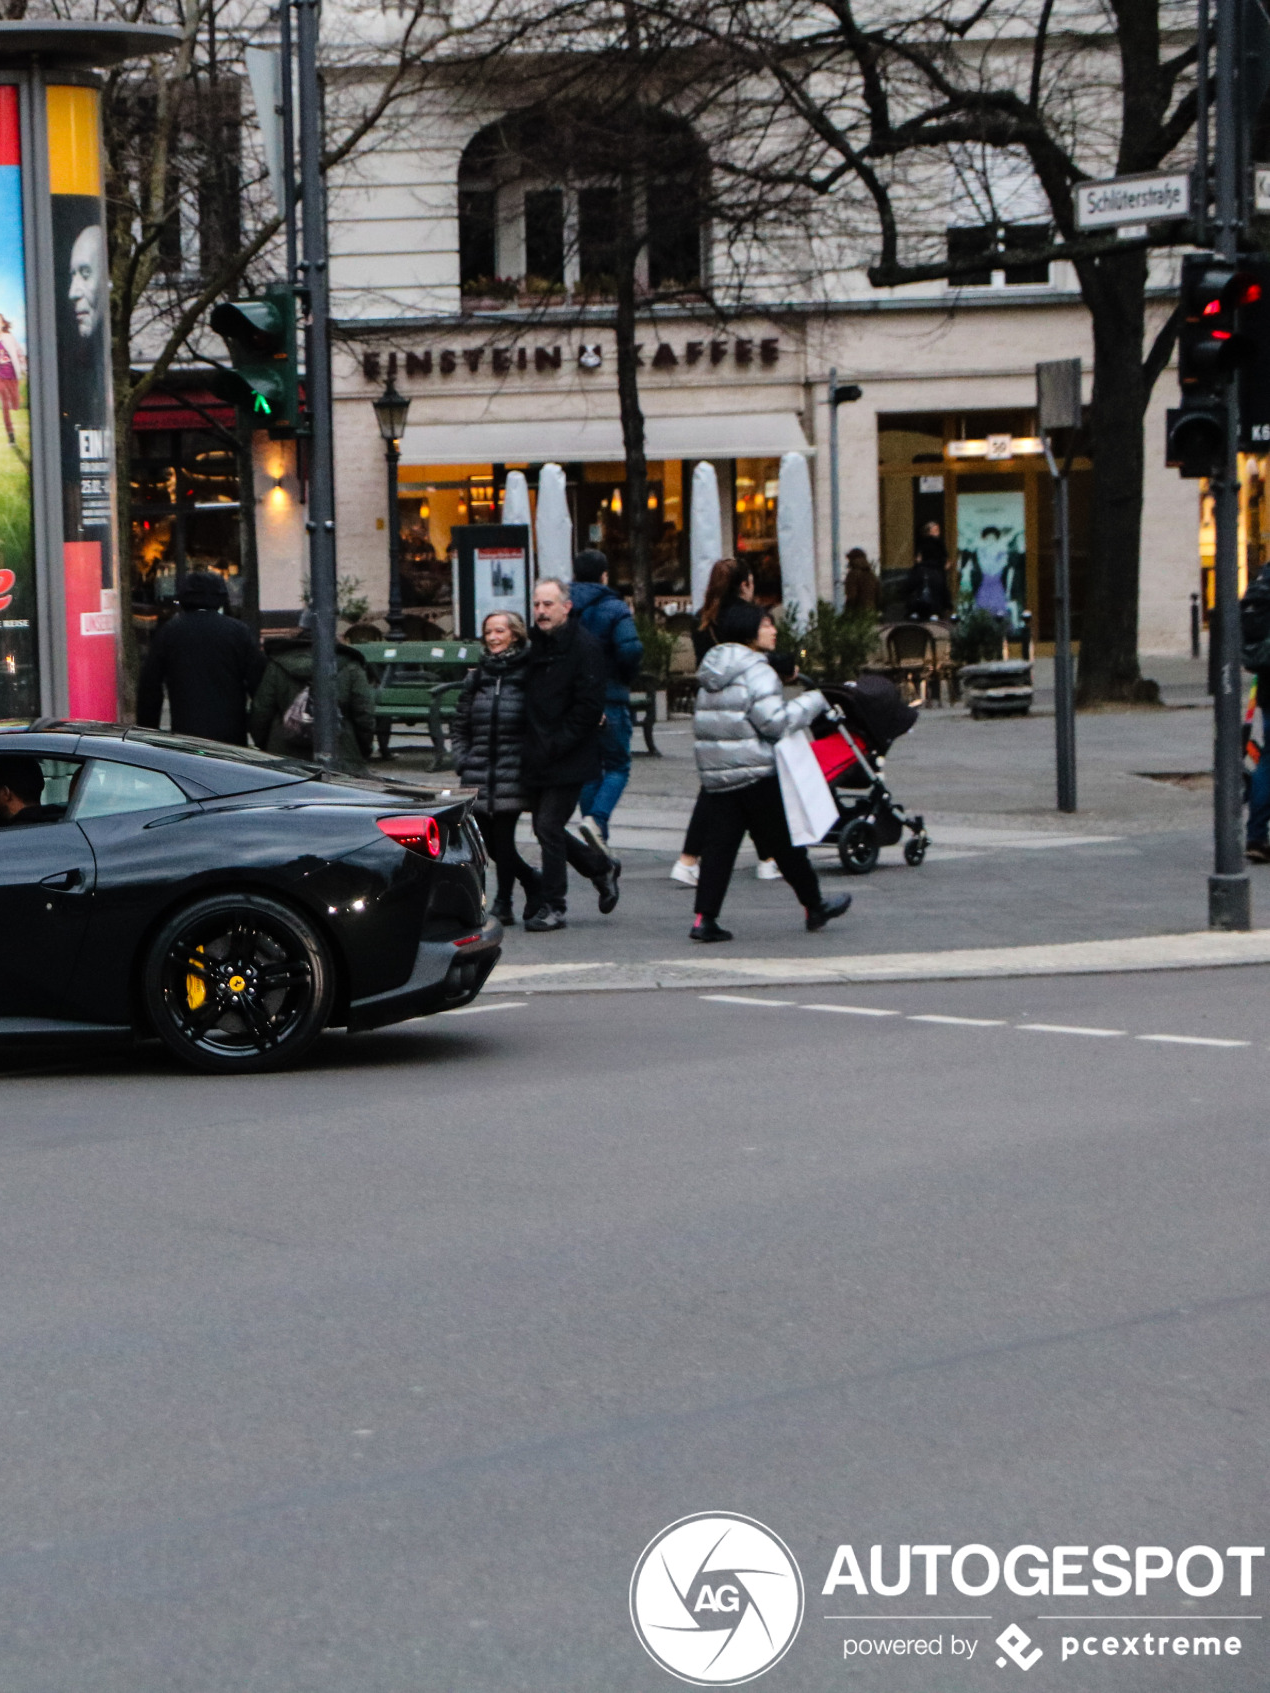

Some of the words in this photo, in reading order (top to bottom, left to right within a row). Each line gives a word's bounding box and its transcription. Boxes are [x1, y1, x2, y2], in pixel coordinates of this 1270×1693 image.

[1086, 182, 1181, 214] Schlüterstraße
[362, 346, 561, 382] EINSTEIN
[2, 619, 30, 628] REISE
